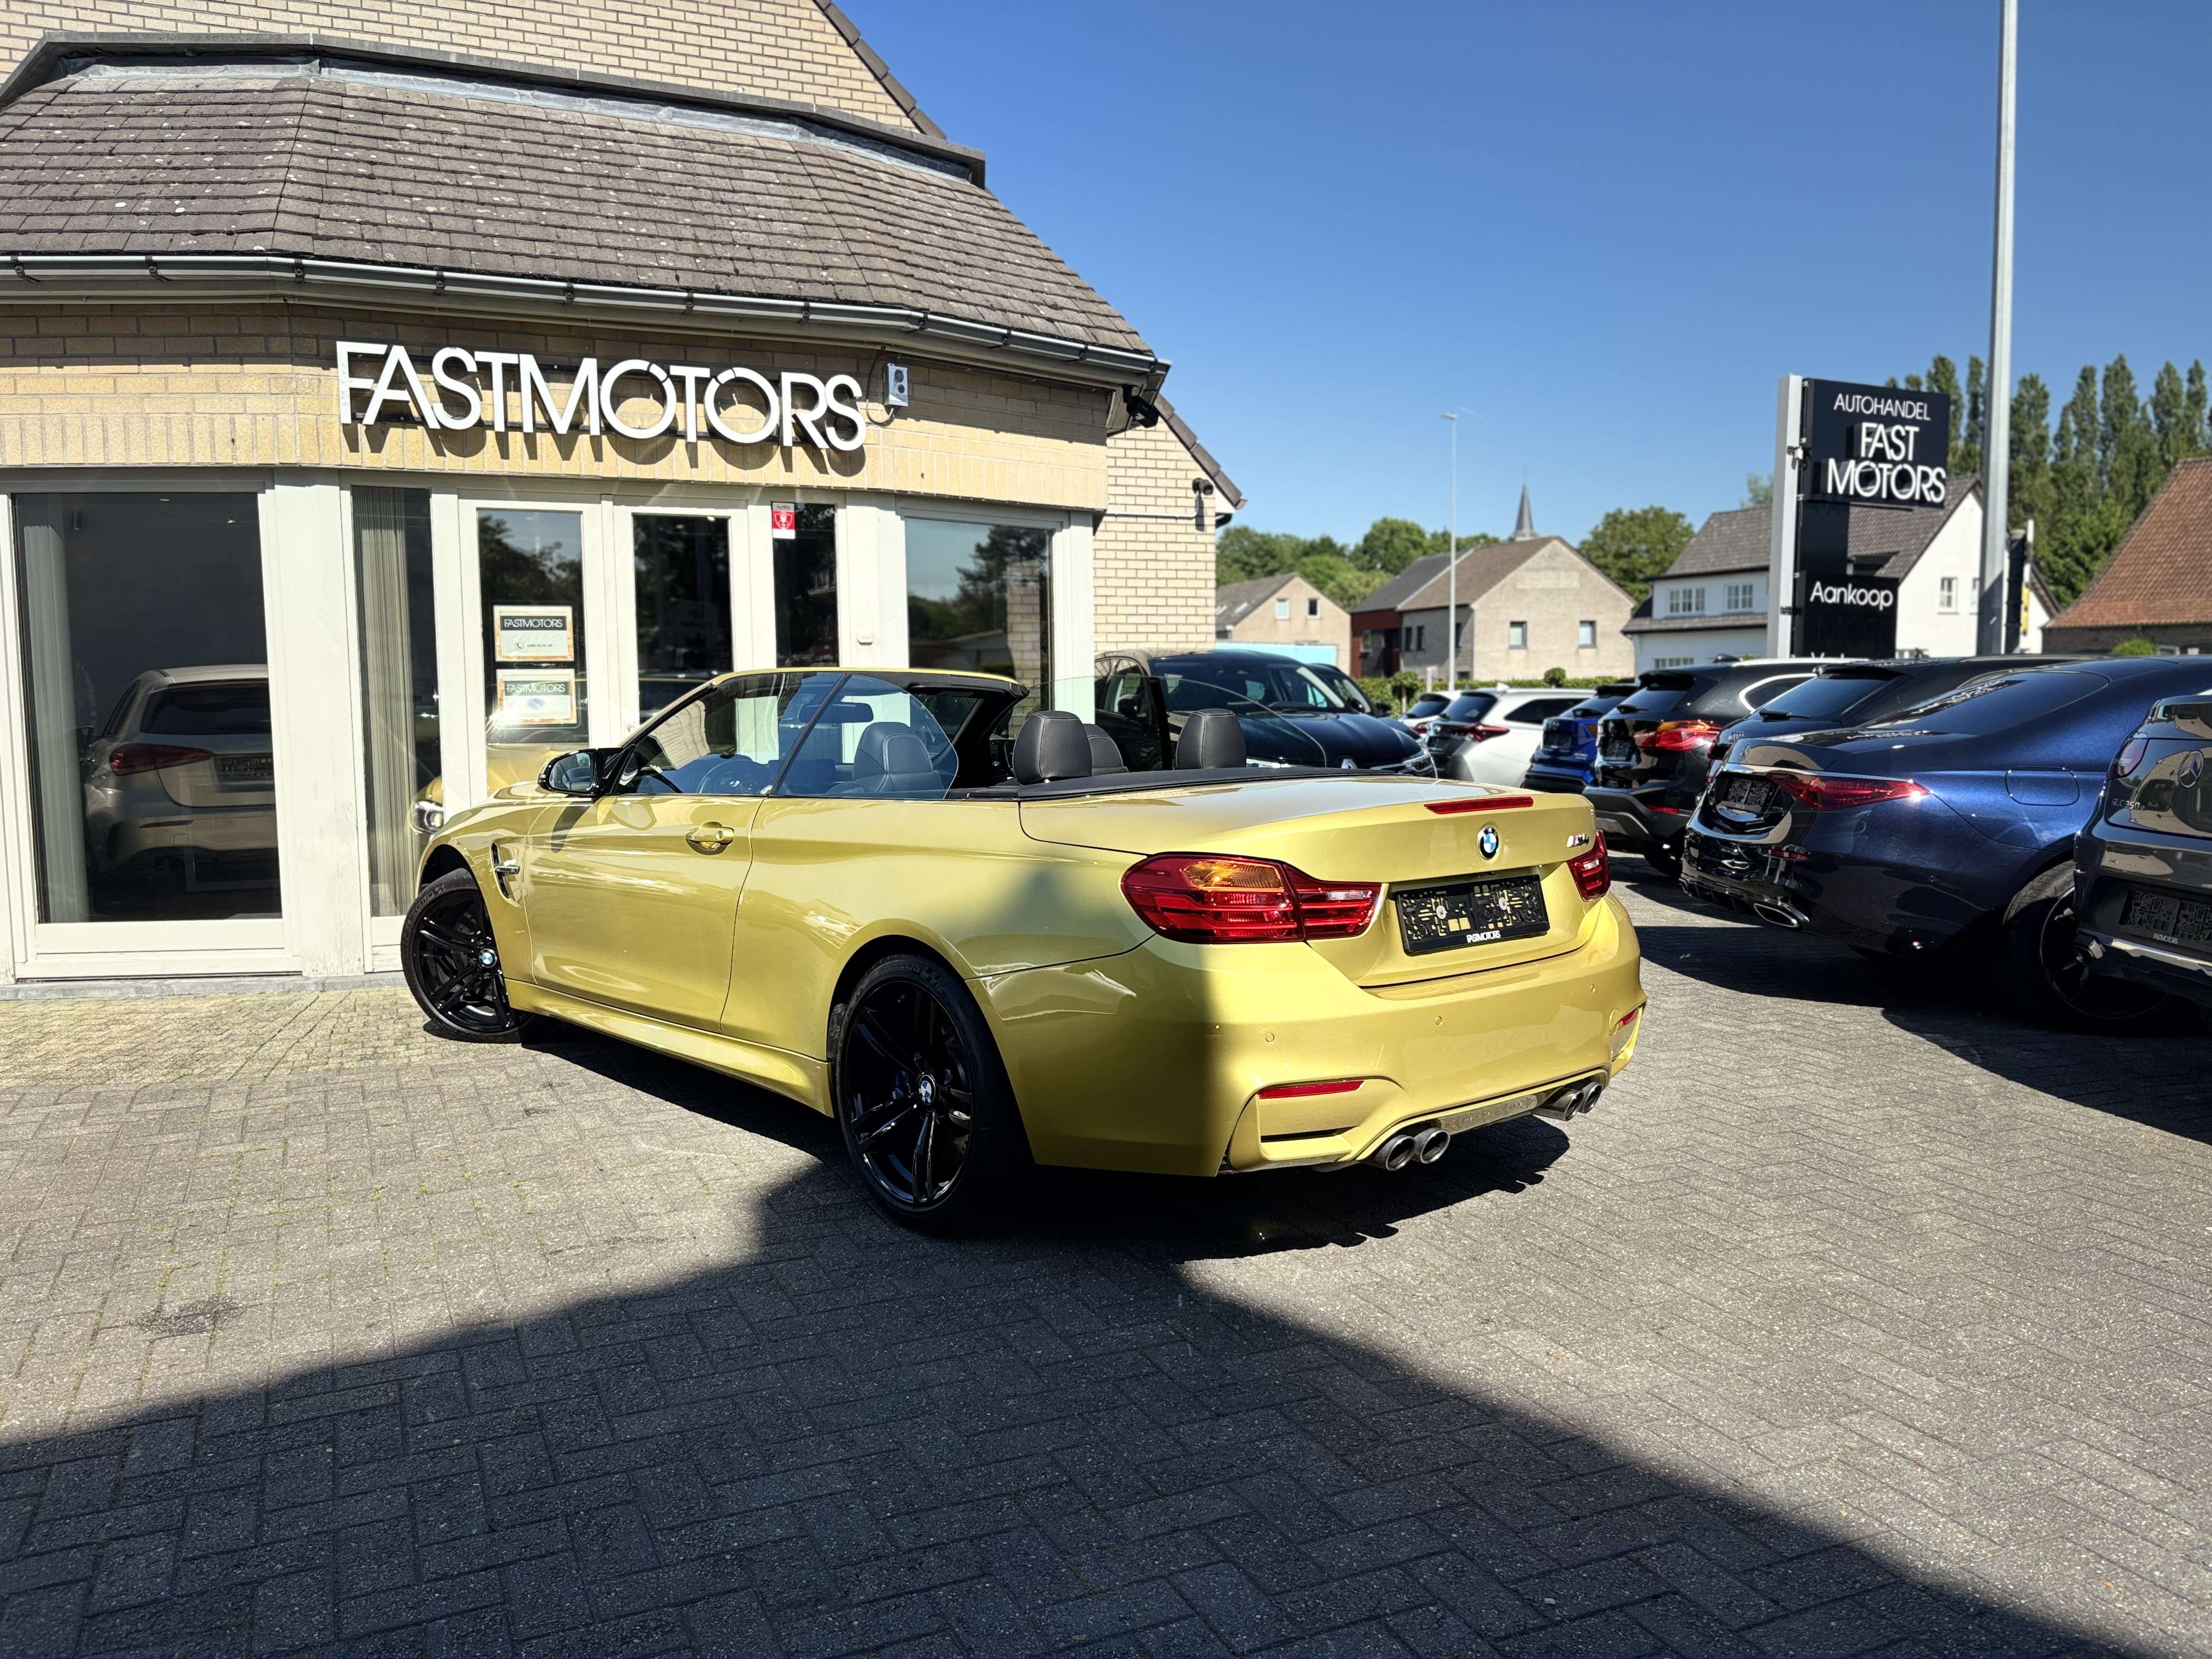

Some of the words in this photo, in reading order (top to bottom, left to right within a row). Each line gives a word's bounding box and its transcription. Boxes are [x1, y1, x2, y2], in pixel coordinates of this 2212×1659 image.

[336, 341, 867, 451] FASTMOTORS
[1833, 393, 1931, 421] AUTOHANDEL
[1860, 422, 1919, 461] FAST
[1827, 458, 1946, 503] MOTORS
[1810, 581, 1893, 611] Aankoop
[504, 618, 563, 628] FASTMOTORS
[506, 683, 566, 693] FASTMOTORS
[409, 890, 435, 923] MICHELIN
